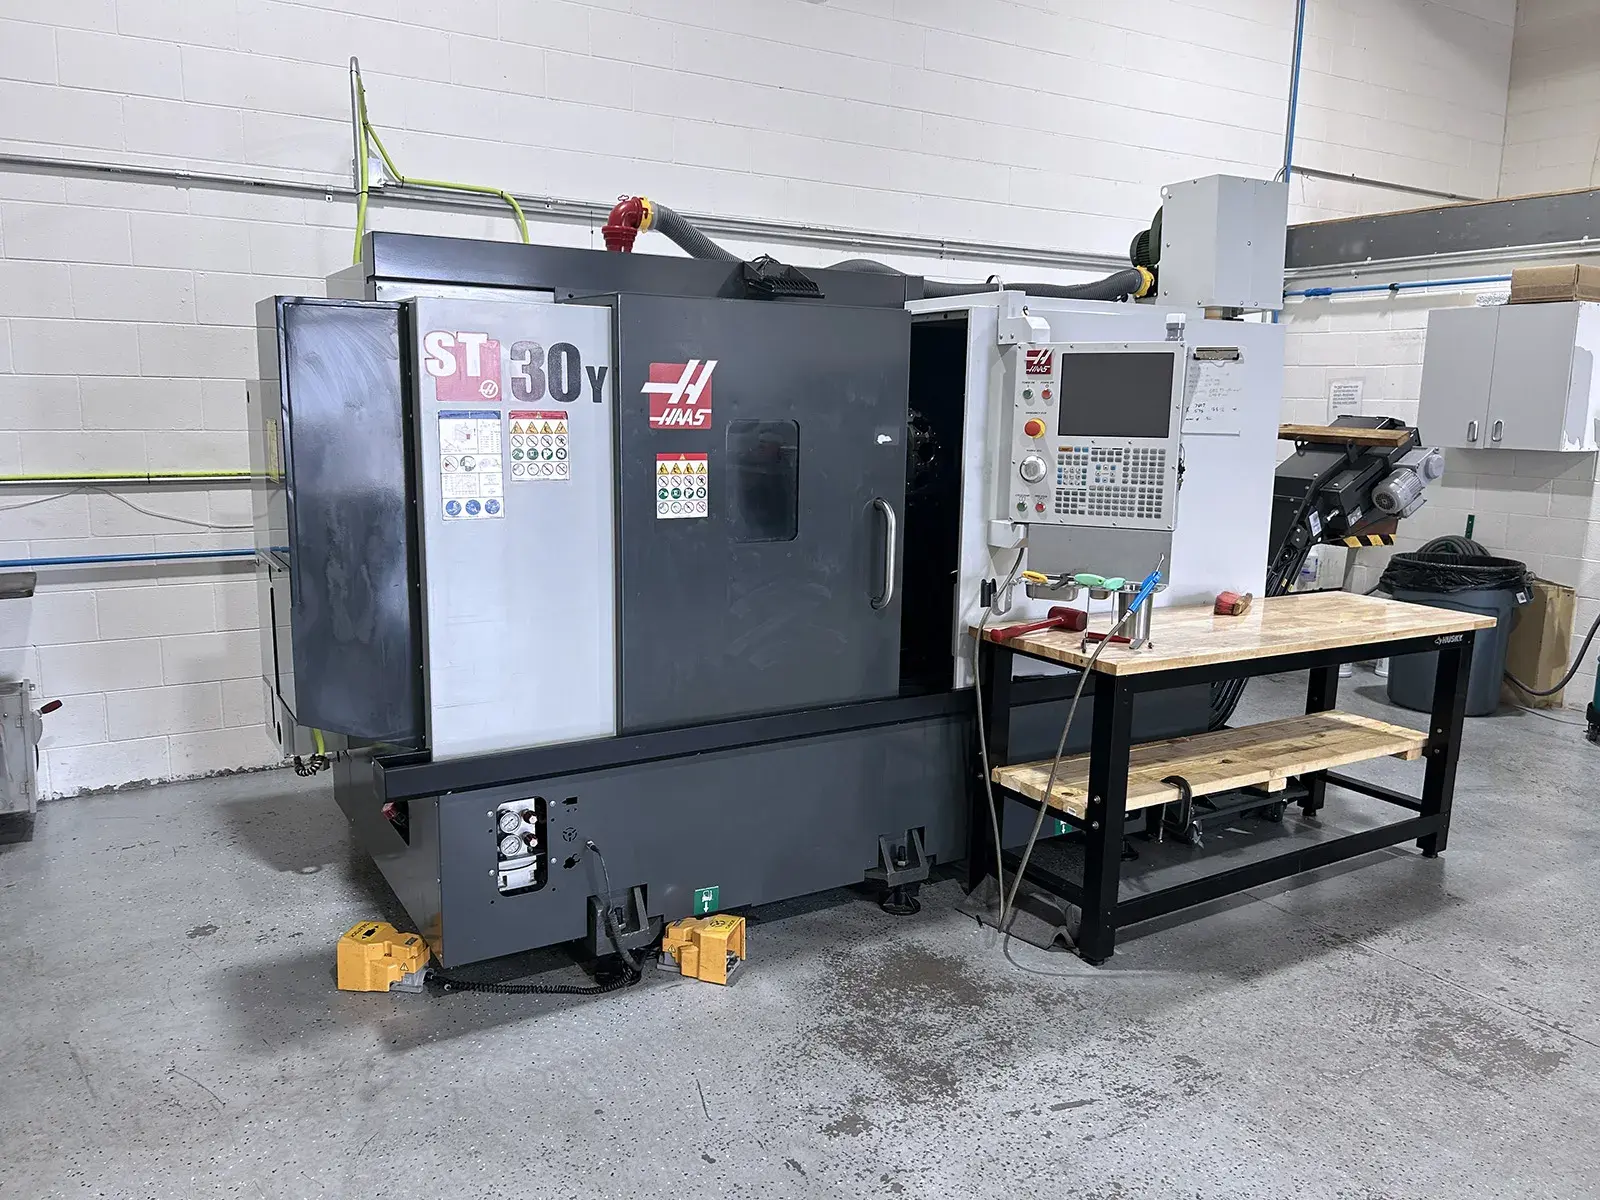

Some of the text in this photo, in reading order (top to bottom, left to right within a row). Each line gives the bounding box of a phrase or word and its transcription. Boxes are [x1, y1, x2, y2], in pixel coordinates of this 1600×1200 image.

[424, 331, 488, 377] ST
[649, 408, 712, 426] HAAS
[1442, 634, 1464, 644] HUSKY
